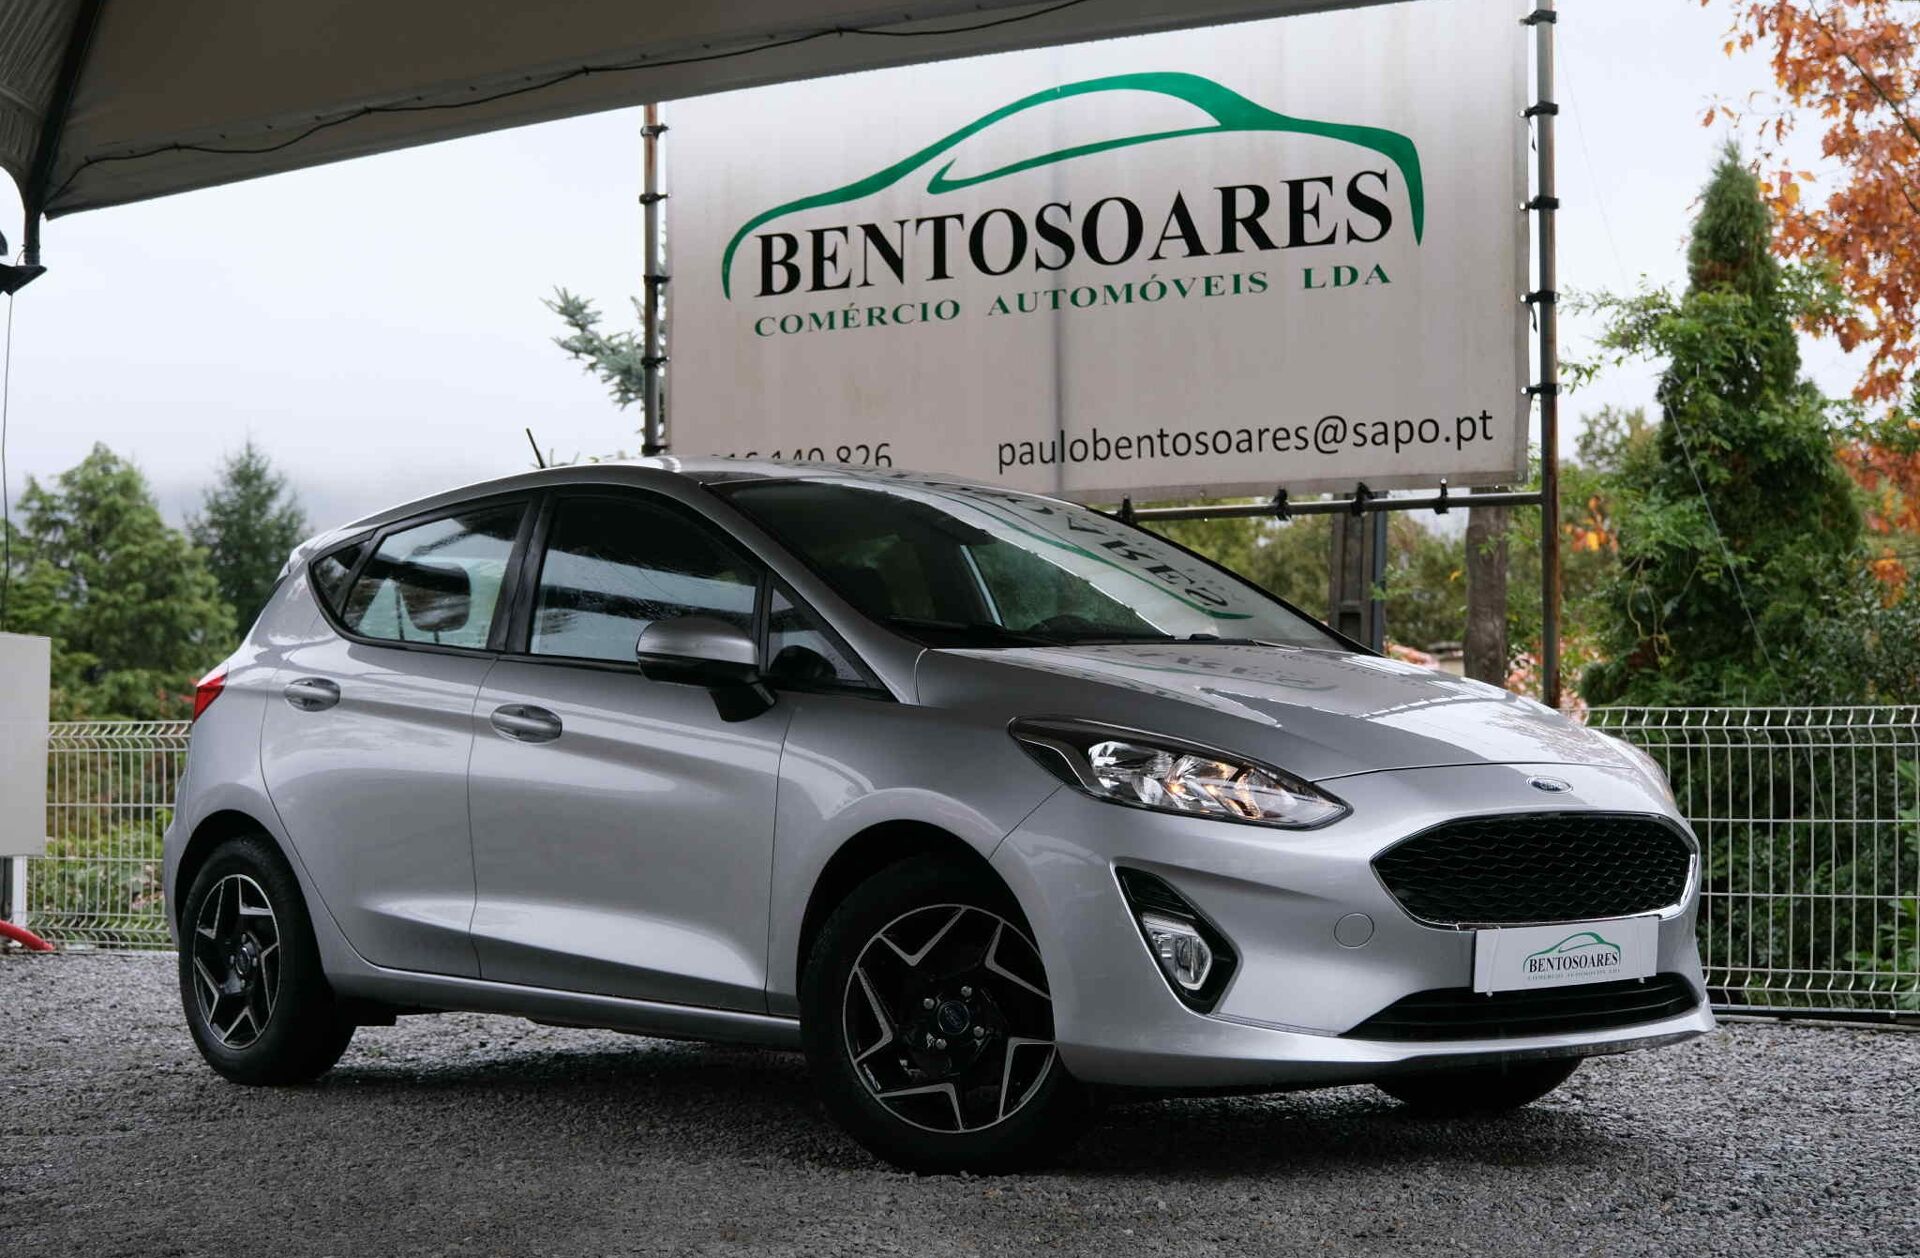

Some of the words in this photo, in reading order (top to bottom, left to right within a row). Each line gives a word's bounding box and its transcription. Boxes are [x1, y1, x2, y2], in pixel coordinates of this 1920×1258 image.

[754, 169, 1393, 298] BENTOSOARES
[754, 299, 961, 337] COMÉRCIO
[988, 271, 1269, 316] AUTOMÓVEIS
[1303, 264, 1392, 290] LDA
[998, 409, 1494, 476] paulobentosoares@sapo.pt
[1529, 952, 1618, 973] BENTOSOARES
